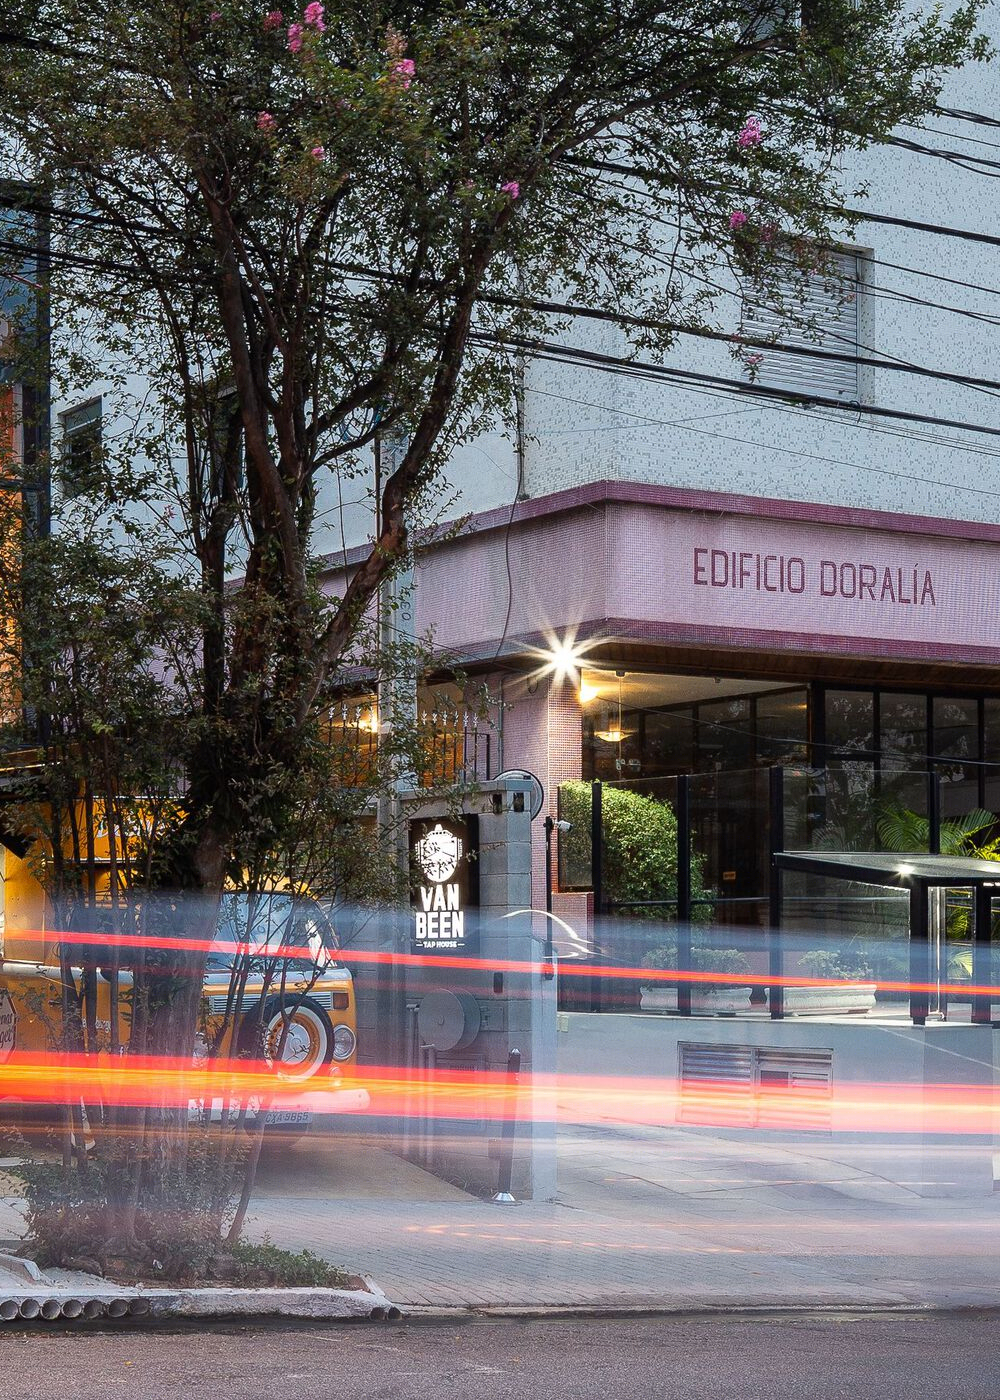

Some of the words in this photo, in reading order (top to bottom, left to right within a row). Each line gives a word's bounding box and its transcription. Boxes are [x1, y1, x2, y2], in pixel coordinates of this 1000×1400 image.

[693, 547, 805, 594] EDIFICIO
[820, 560, 936, 606] DORALÍA
[420, 884, 459, 911] VAN
[416, 911, 464, 939] BEEN
[423, 941, 436, 949] TAP
